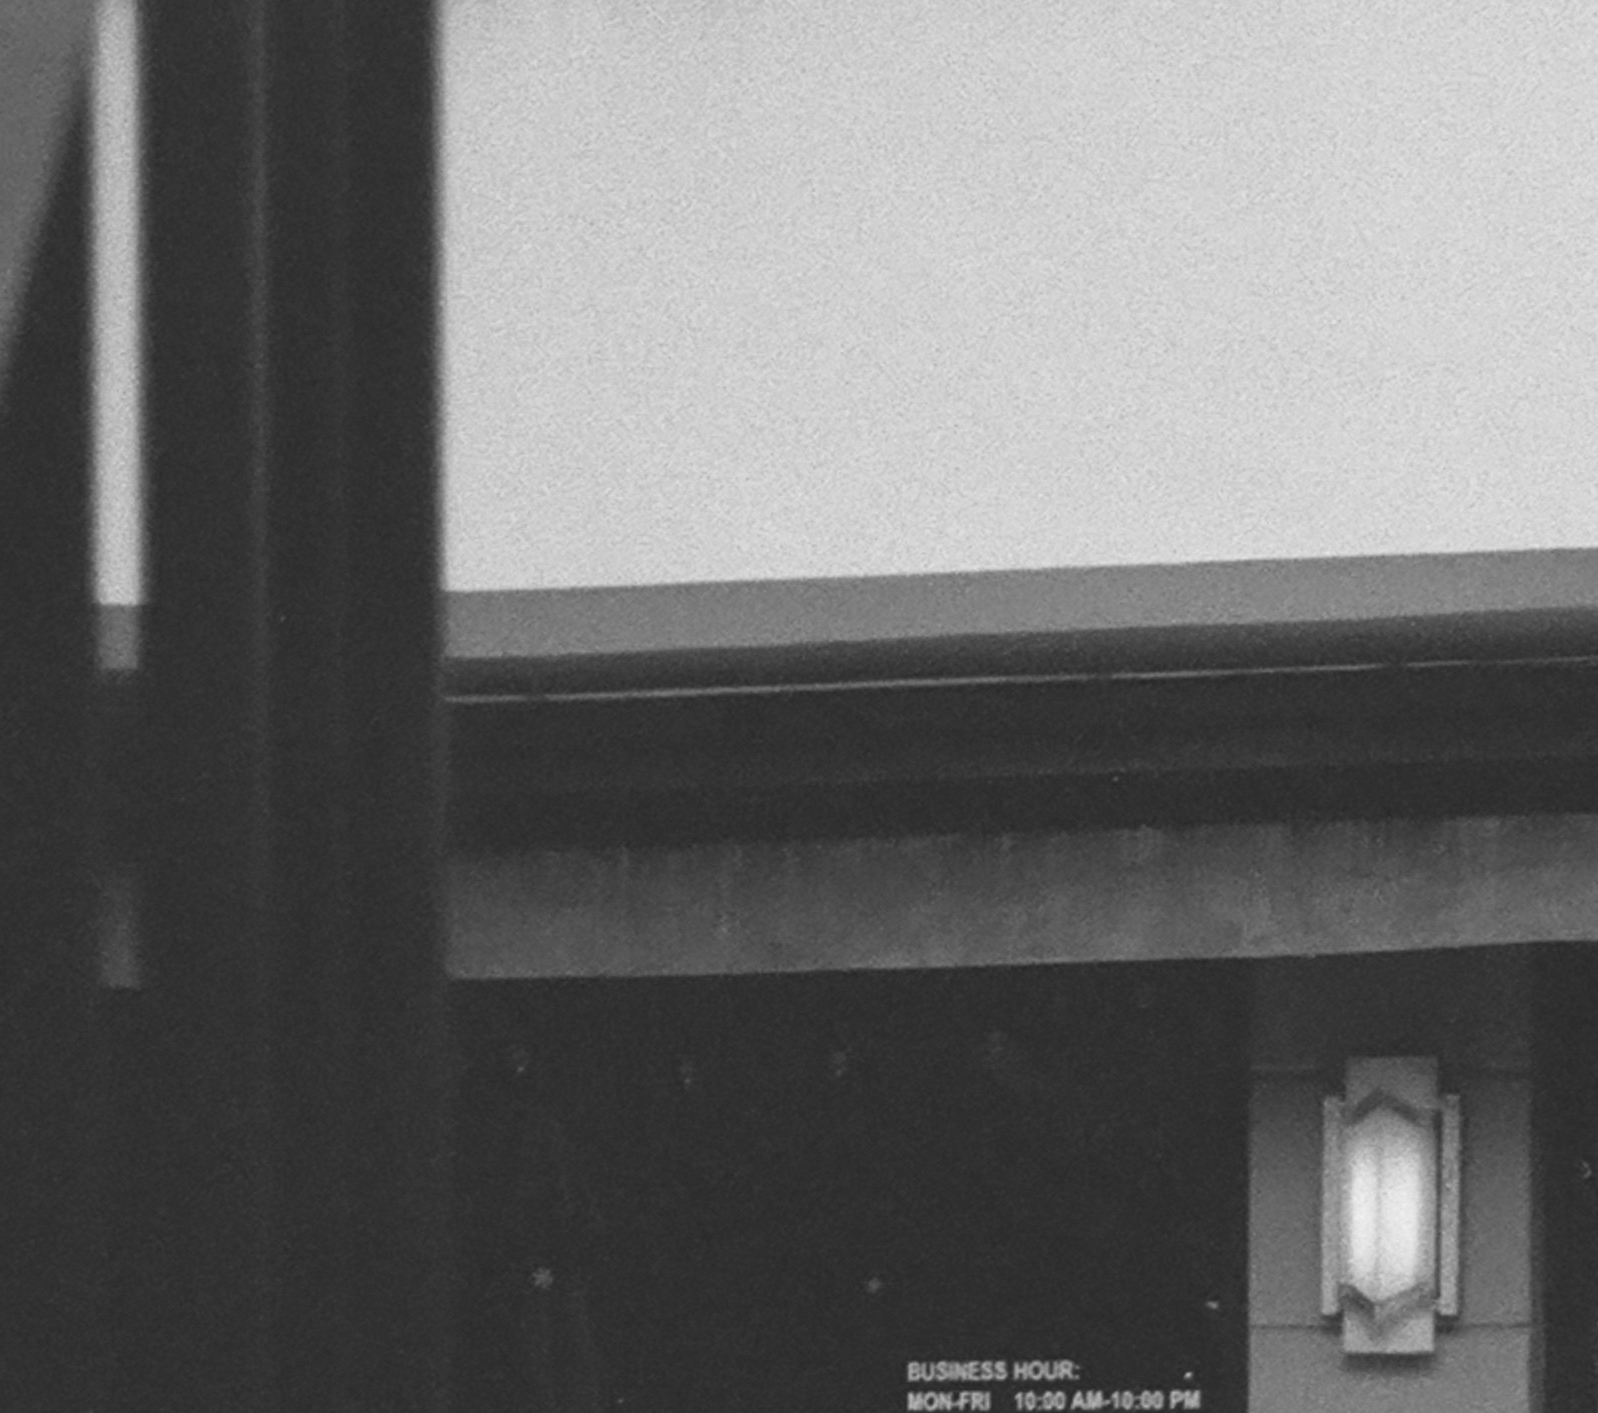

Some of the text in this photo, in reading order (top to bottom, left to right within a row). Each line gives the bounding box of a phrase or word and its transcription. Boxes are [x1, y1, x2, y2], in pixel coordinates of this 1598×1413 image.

[906, 1360, 1081, 1382] BUSINESS HOUR:
[906, 1391, 992, 1412] MON-FRI
[1014, 1391, 1066, 1411] 10:00
[1169, 1389, 1202, 1410] PM
